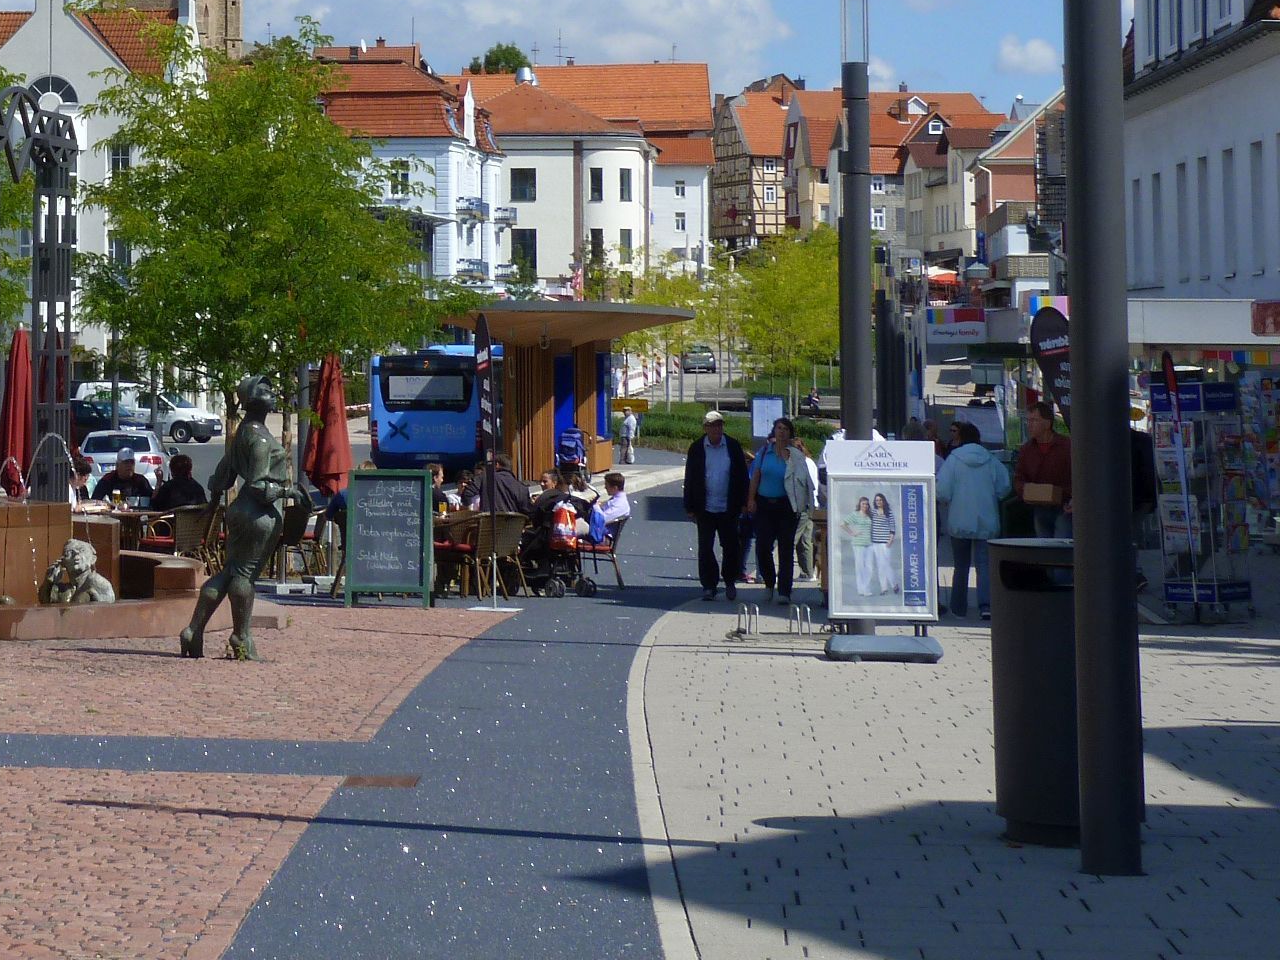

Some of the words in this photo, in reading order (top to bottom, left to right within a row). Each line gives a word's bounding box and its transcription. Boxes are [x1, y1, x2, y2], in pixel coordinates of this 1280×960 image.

[908, 488, 918, 524] ERLEBEN
[909, 527, 918, 543] NEU
[910, 553, 919, 588] SOMMER
